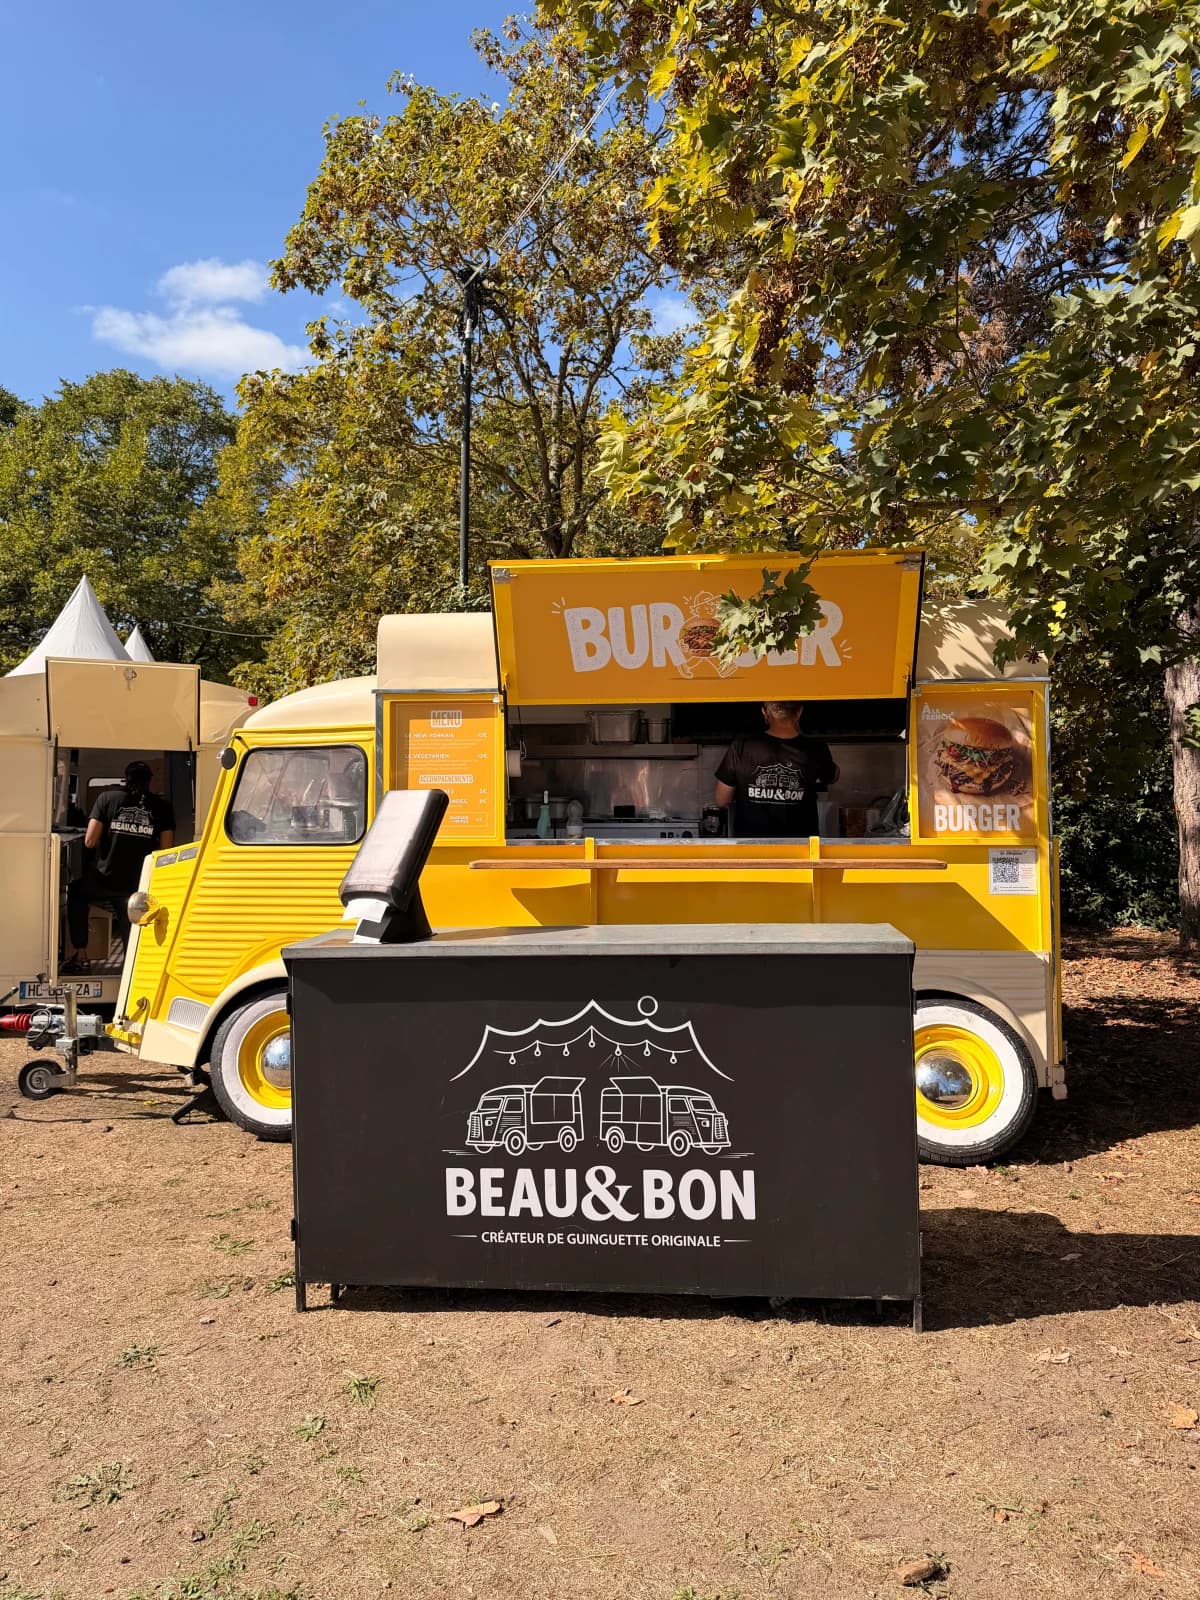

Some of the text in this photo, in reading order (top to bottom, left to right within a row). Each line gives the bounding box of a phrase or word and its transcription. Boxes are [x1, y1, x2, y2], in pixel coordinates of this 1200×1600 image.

[563, 600, 843, 673] BURR
[432, 711, 462, 726] MENU
[934, 803, 1021, 832] BURGER
[481, 1230, 721, 1248] CRÉATEUR DE GUINGUETTE ORIGINALE
